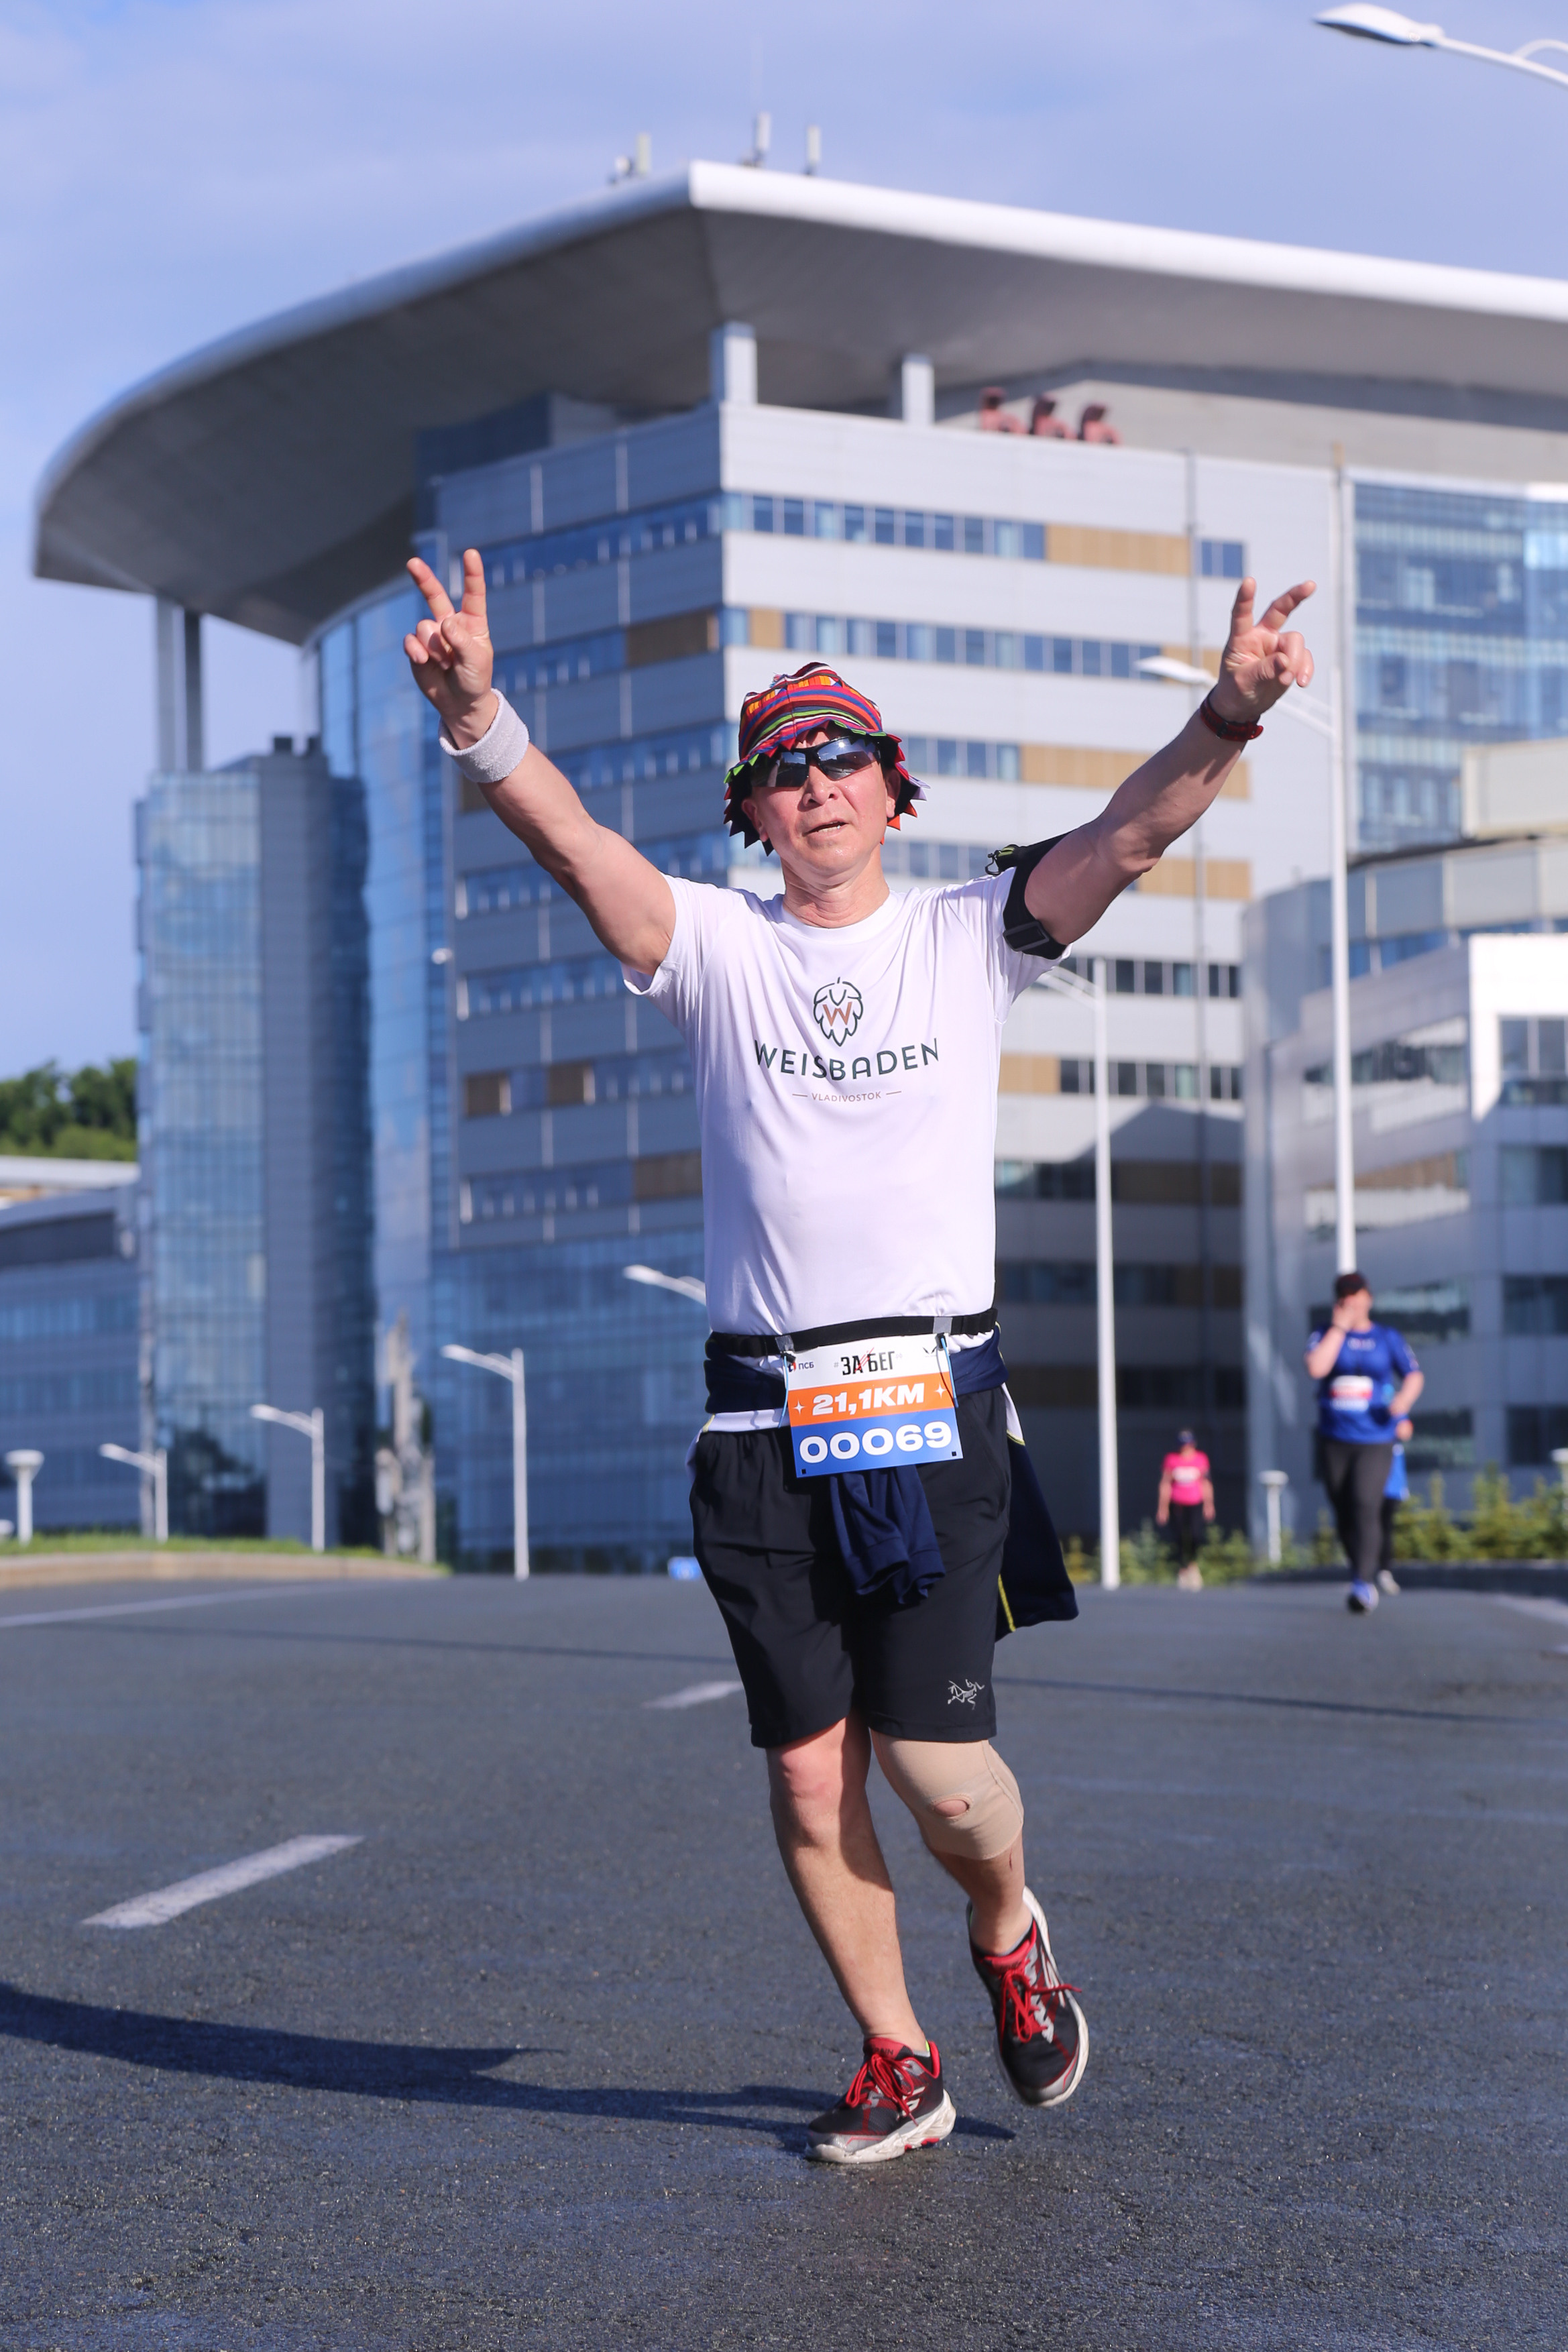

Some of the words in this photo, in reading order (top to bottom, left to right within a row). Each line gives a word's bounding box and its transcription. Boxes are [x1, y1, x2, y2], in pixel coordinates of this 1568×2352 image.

[754, 1038, 939, 1081] WEISBADEN
[811, 1091, 881, 1102] VLADIVOSTOK
[798, 1361, 814, 1369] ПСБ
[799, 1420, 952, 1463] 00069
